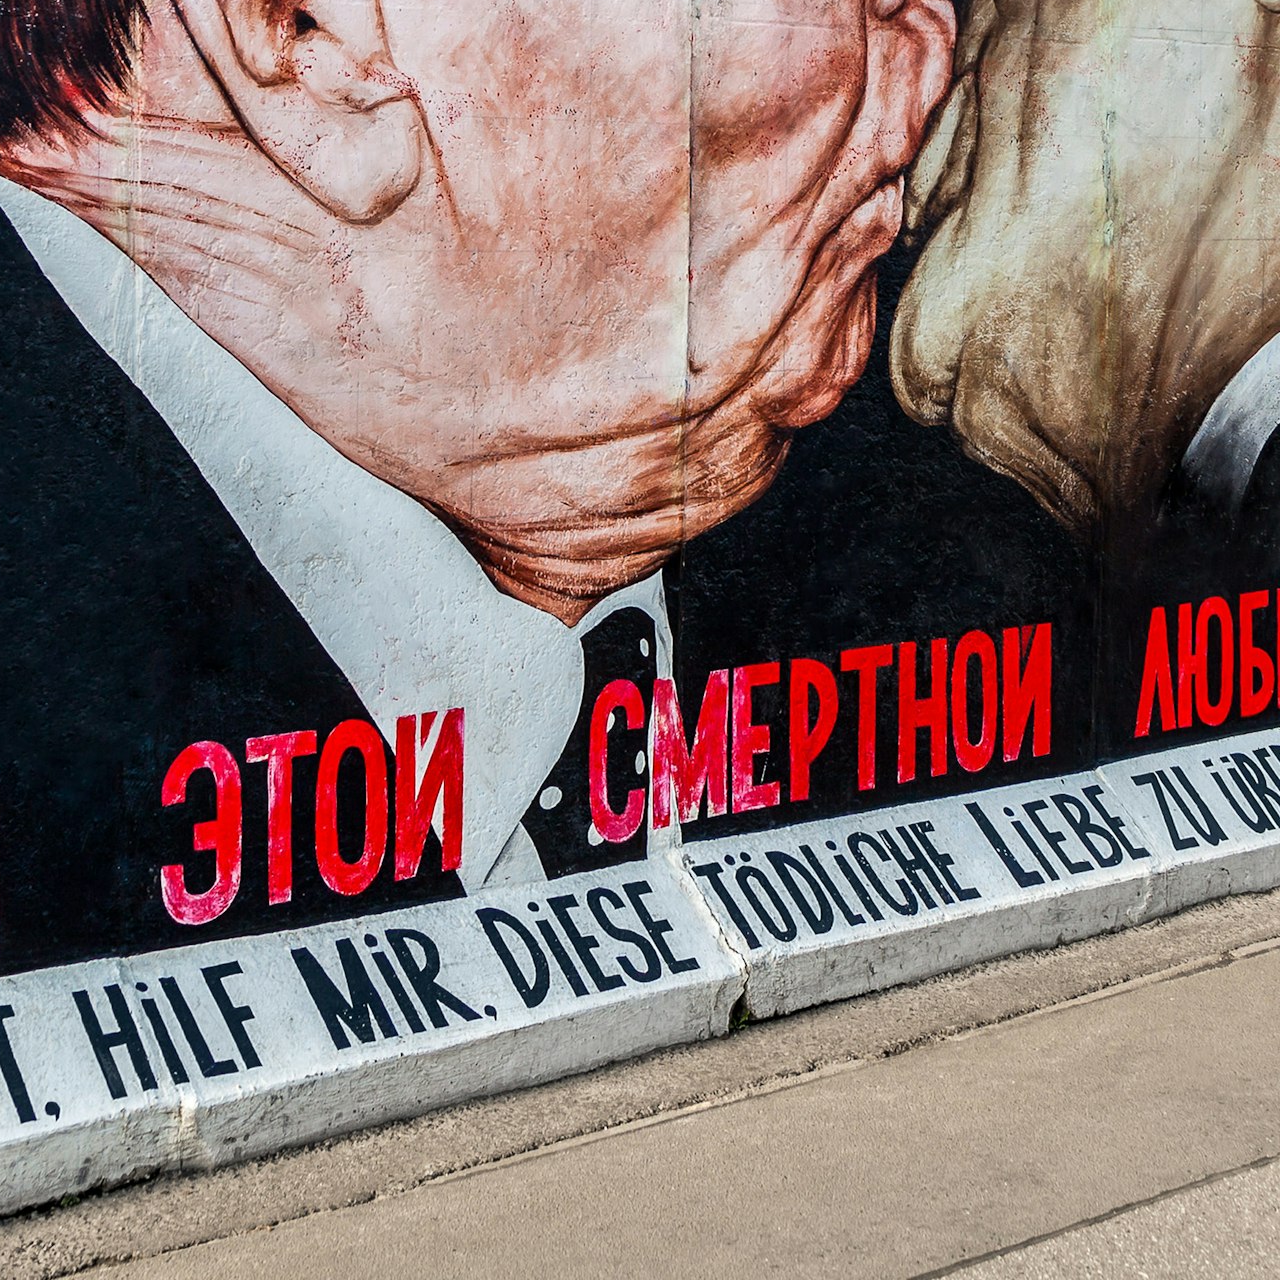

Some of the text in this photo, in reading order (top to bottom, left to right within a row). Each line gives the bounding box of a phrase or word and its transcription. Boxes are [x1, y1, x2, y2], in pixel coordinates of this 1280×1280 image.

[161, 707, 466, 925] ЭТОЙ
[588, 622, 1053, 845] СМЕРТНОЙ
[1132, 766, 1224, 851] ZU
